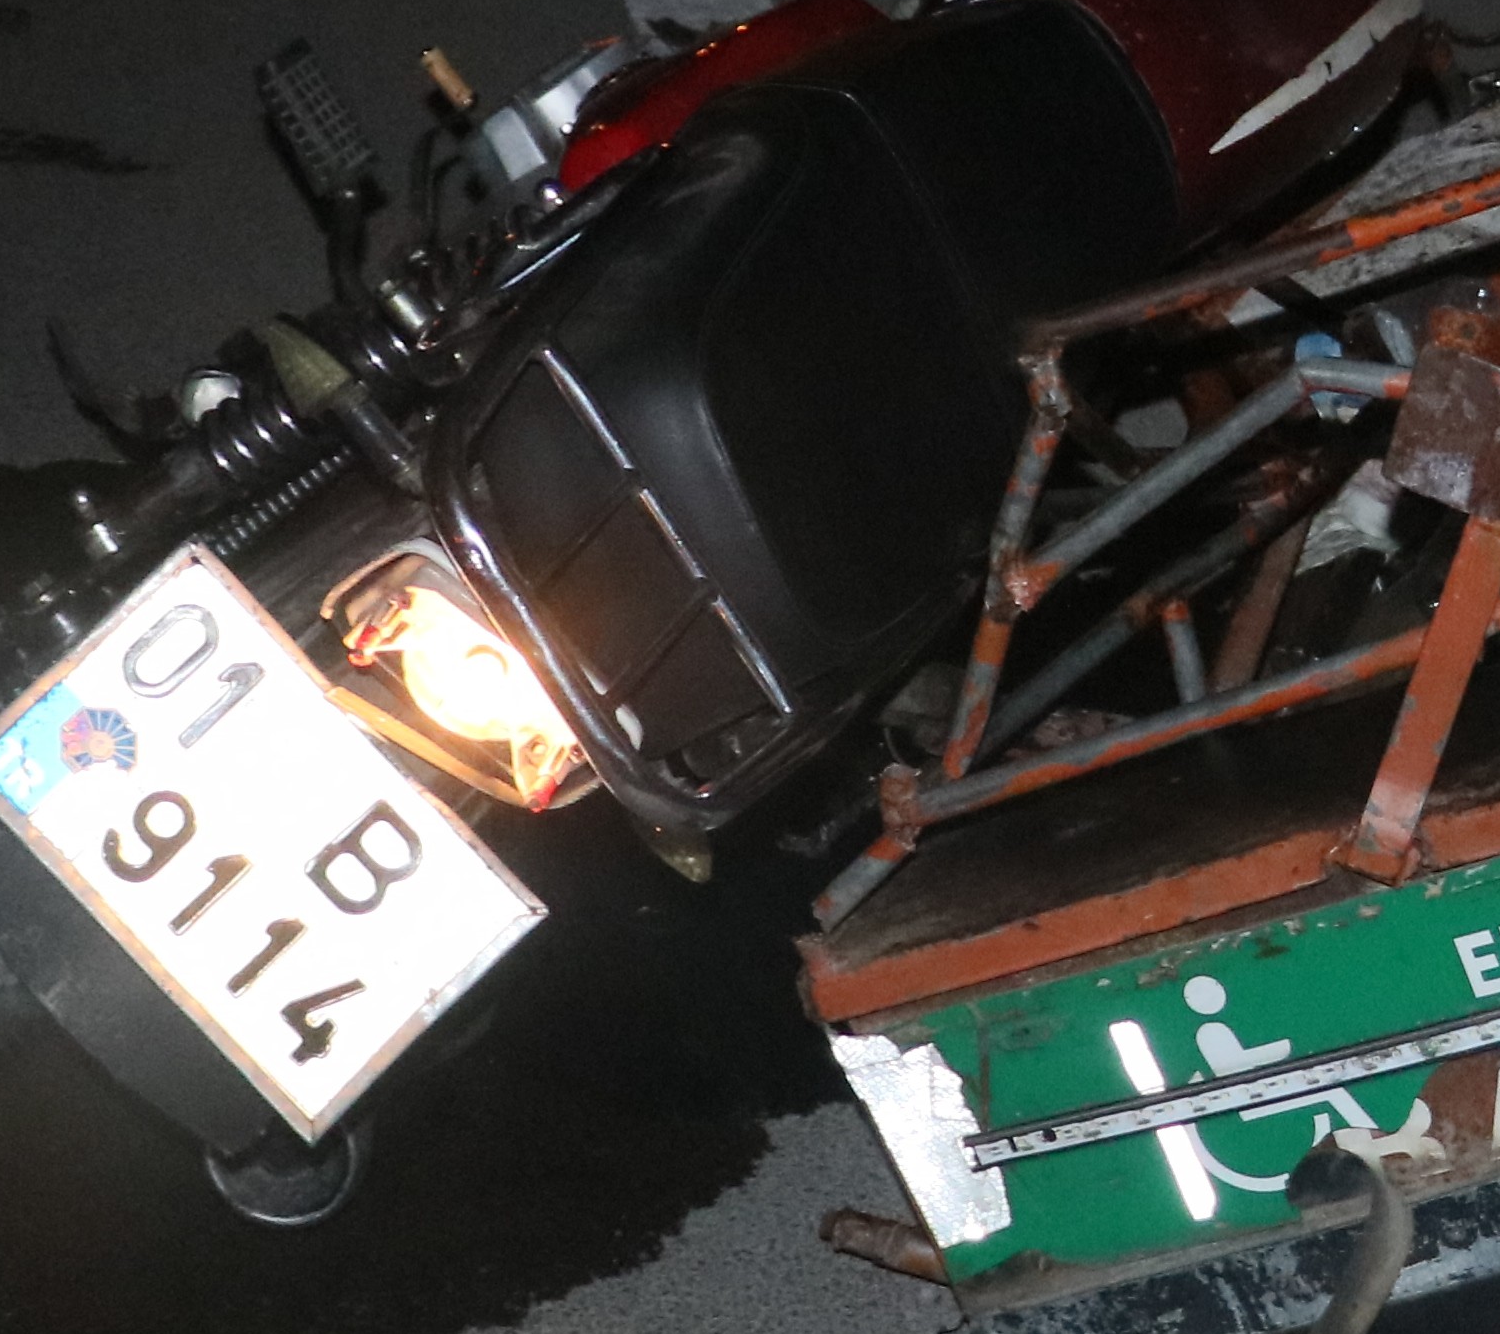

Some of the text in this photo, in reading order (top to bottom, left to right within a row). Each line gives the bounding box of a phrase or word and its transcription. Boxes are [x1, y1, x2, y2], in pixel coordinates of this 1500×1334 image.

[122, 604, 422, 915] 01 B
[102, 790, 366, 1065] 9114
